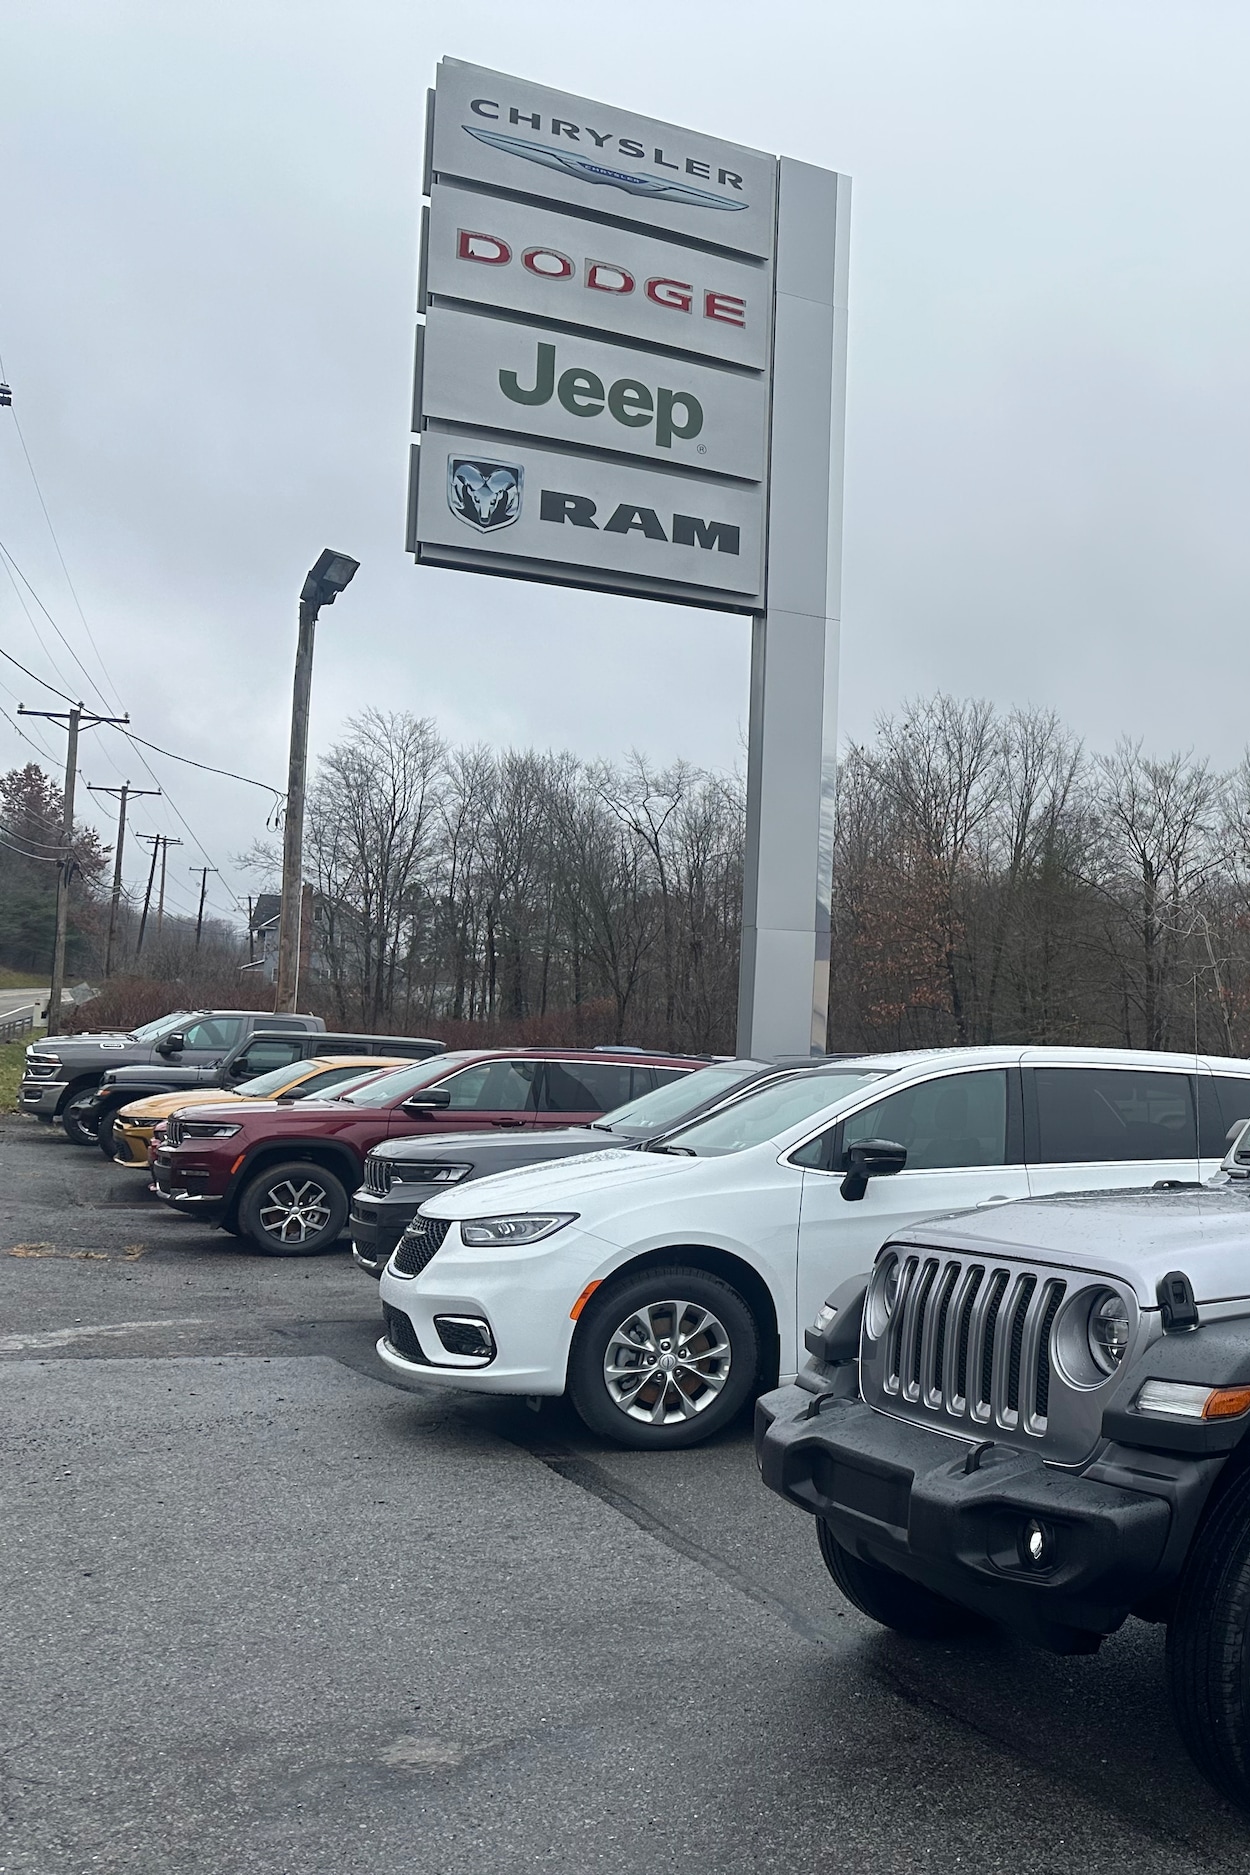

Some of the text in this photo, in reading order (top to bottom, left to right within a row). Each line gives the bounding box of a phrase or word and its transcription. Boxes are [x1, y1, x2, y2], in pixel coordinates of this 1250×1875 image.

[470, 98, 744, 191] CHRYSLER
[584, 164, 641, 184] CHRYSLER
[456, 228, 747, 329] DODGE
[498, 342, 704, 449] Jeep
[540, 489, 740, 556] RAM
